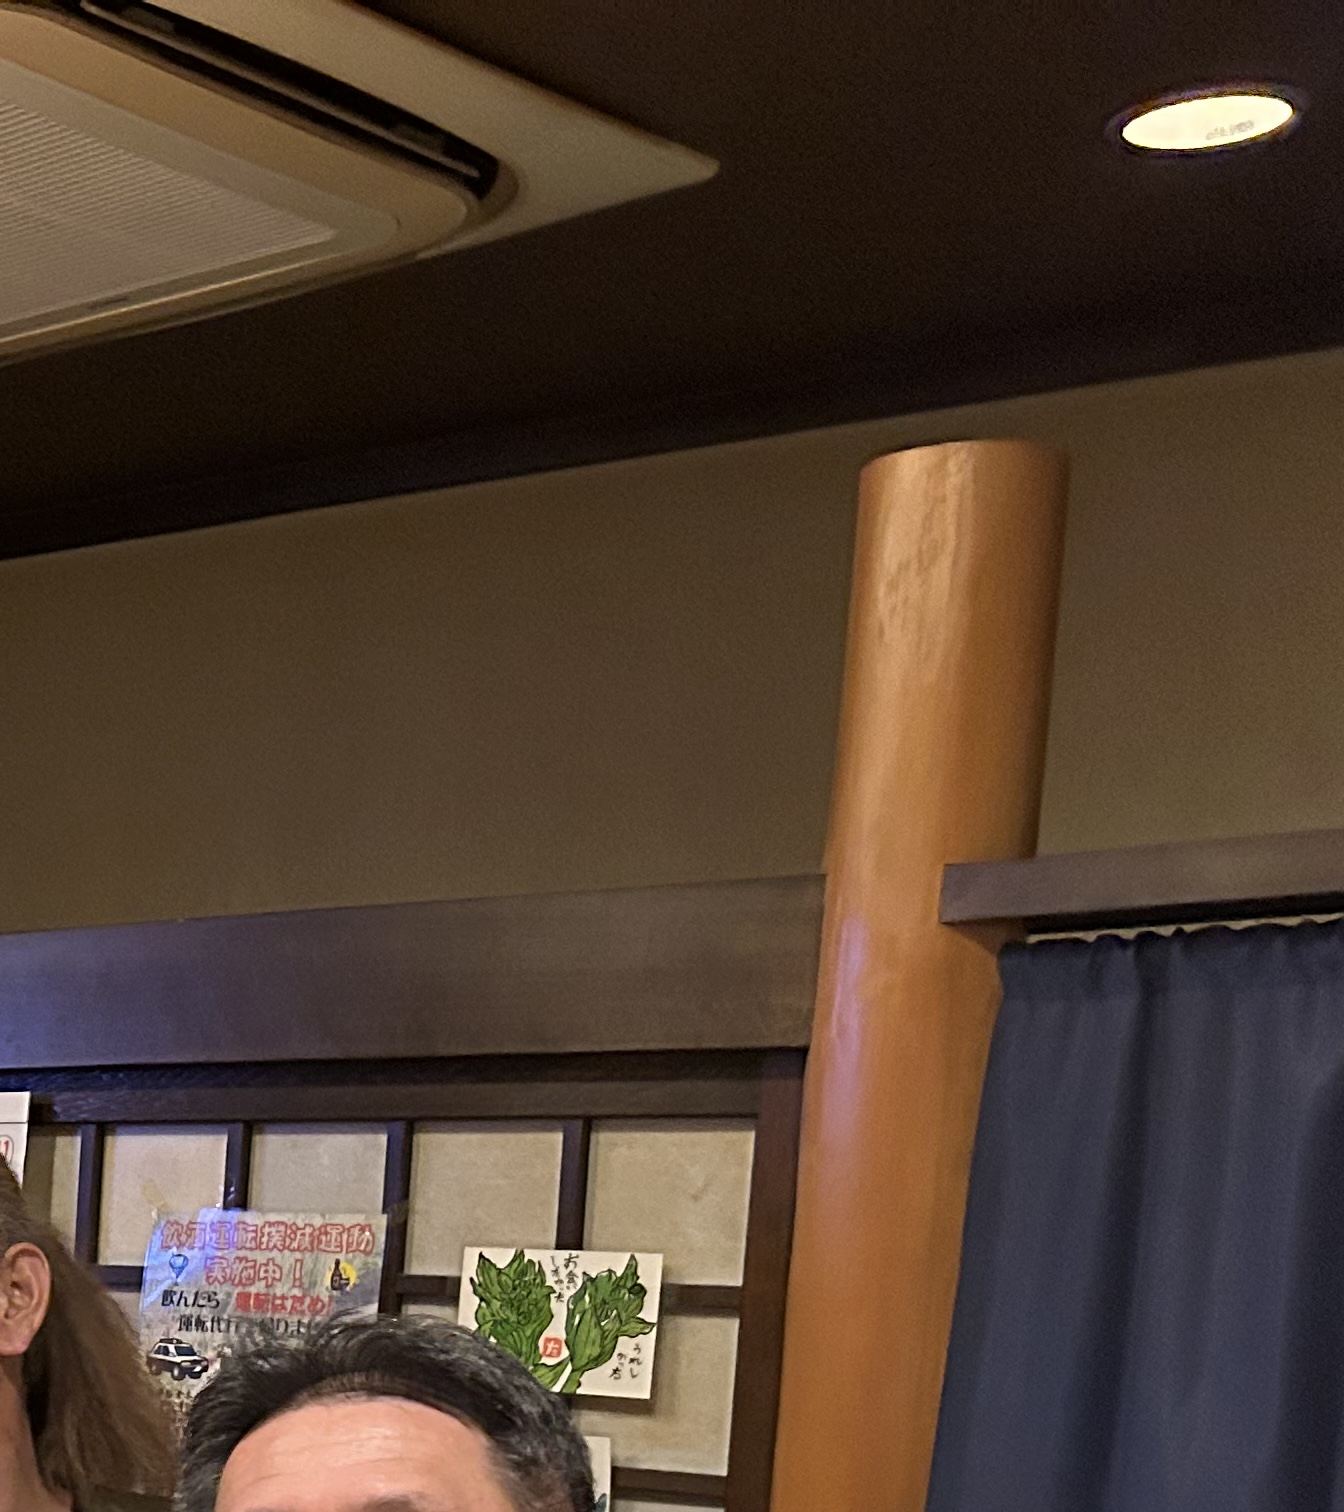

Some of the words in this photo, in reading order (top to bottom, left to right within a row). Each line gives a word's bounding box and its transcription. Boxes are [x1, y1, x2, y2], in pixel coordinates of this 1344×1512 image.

[162, 1221, 375, 1255] 飲酒運転撲滅運動
[162, 1290, 220, 1309] 飲んだら
